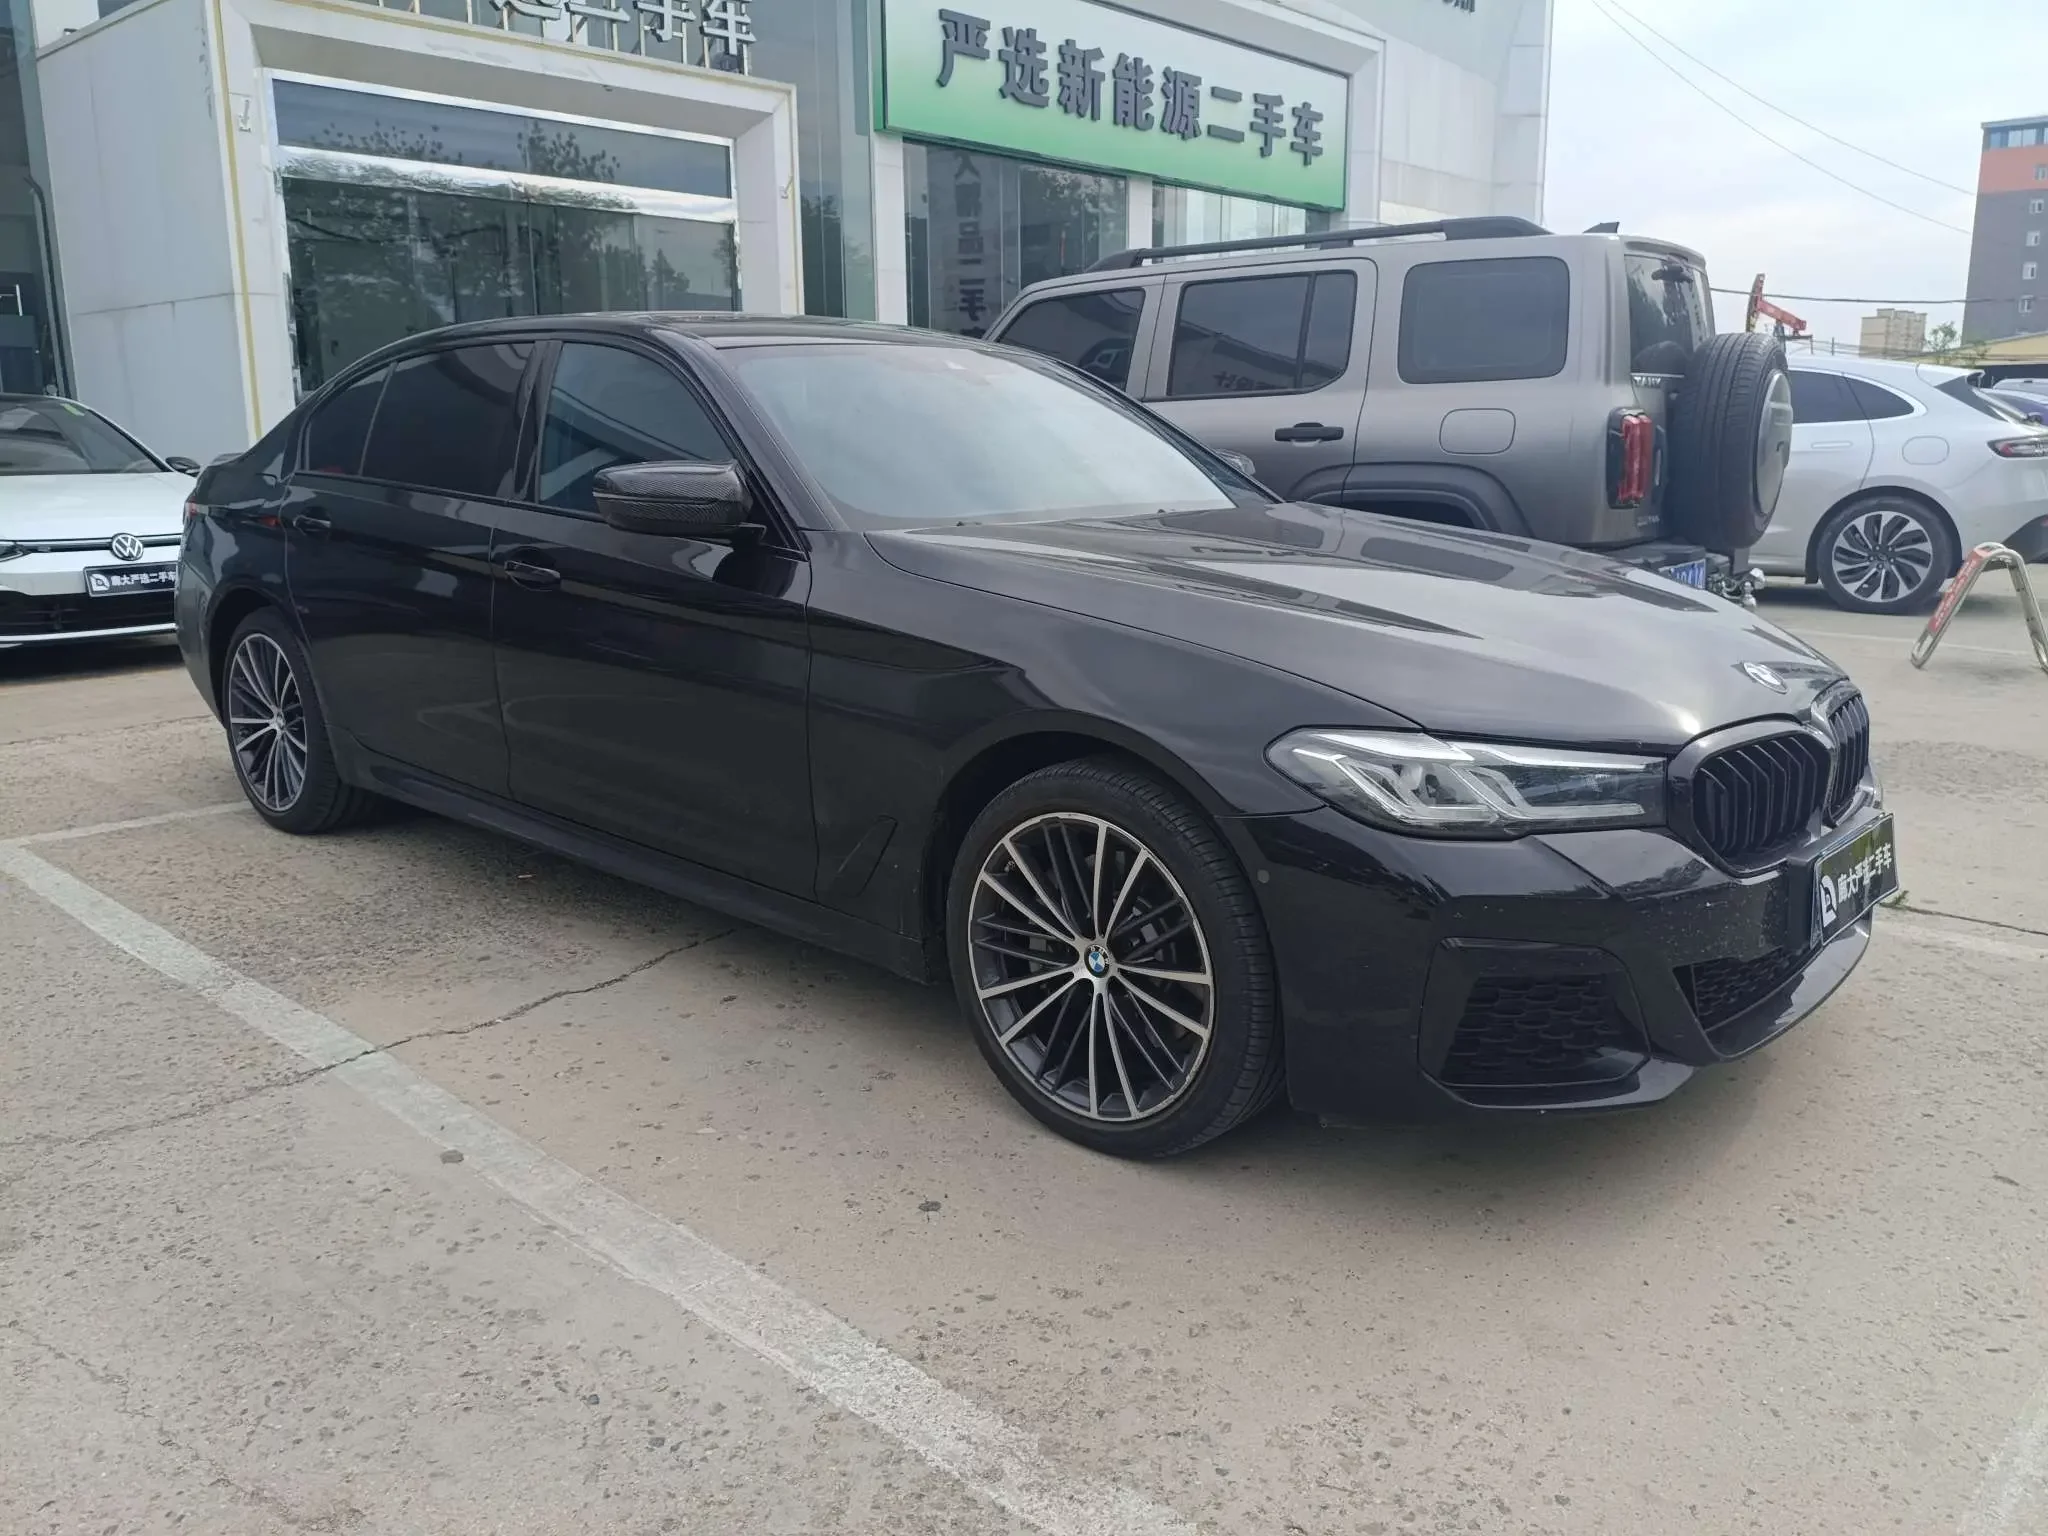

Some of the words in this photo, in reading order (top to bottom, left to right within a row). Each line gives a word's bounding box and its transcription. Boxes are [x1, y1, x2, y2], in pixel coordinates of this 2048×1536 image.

[936, 8, 1324, 166] 严选新能源二手车
